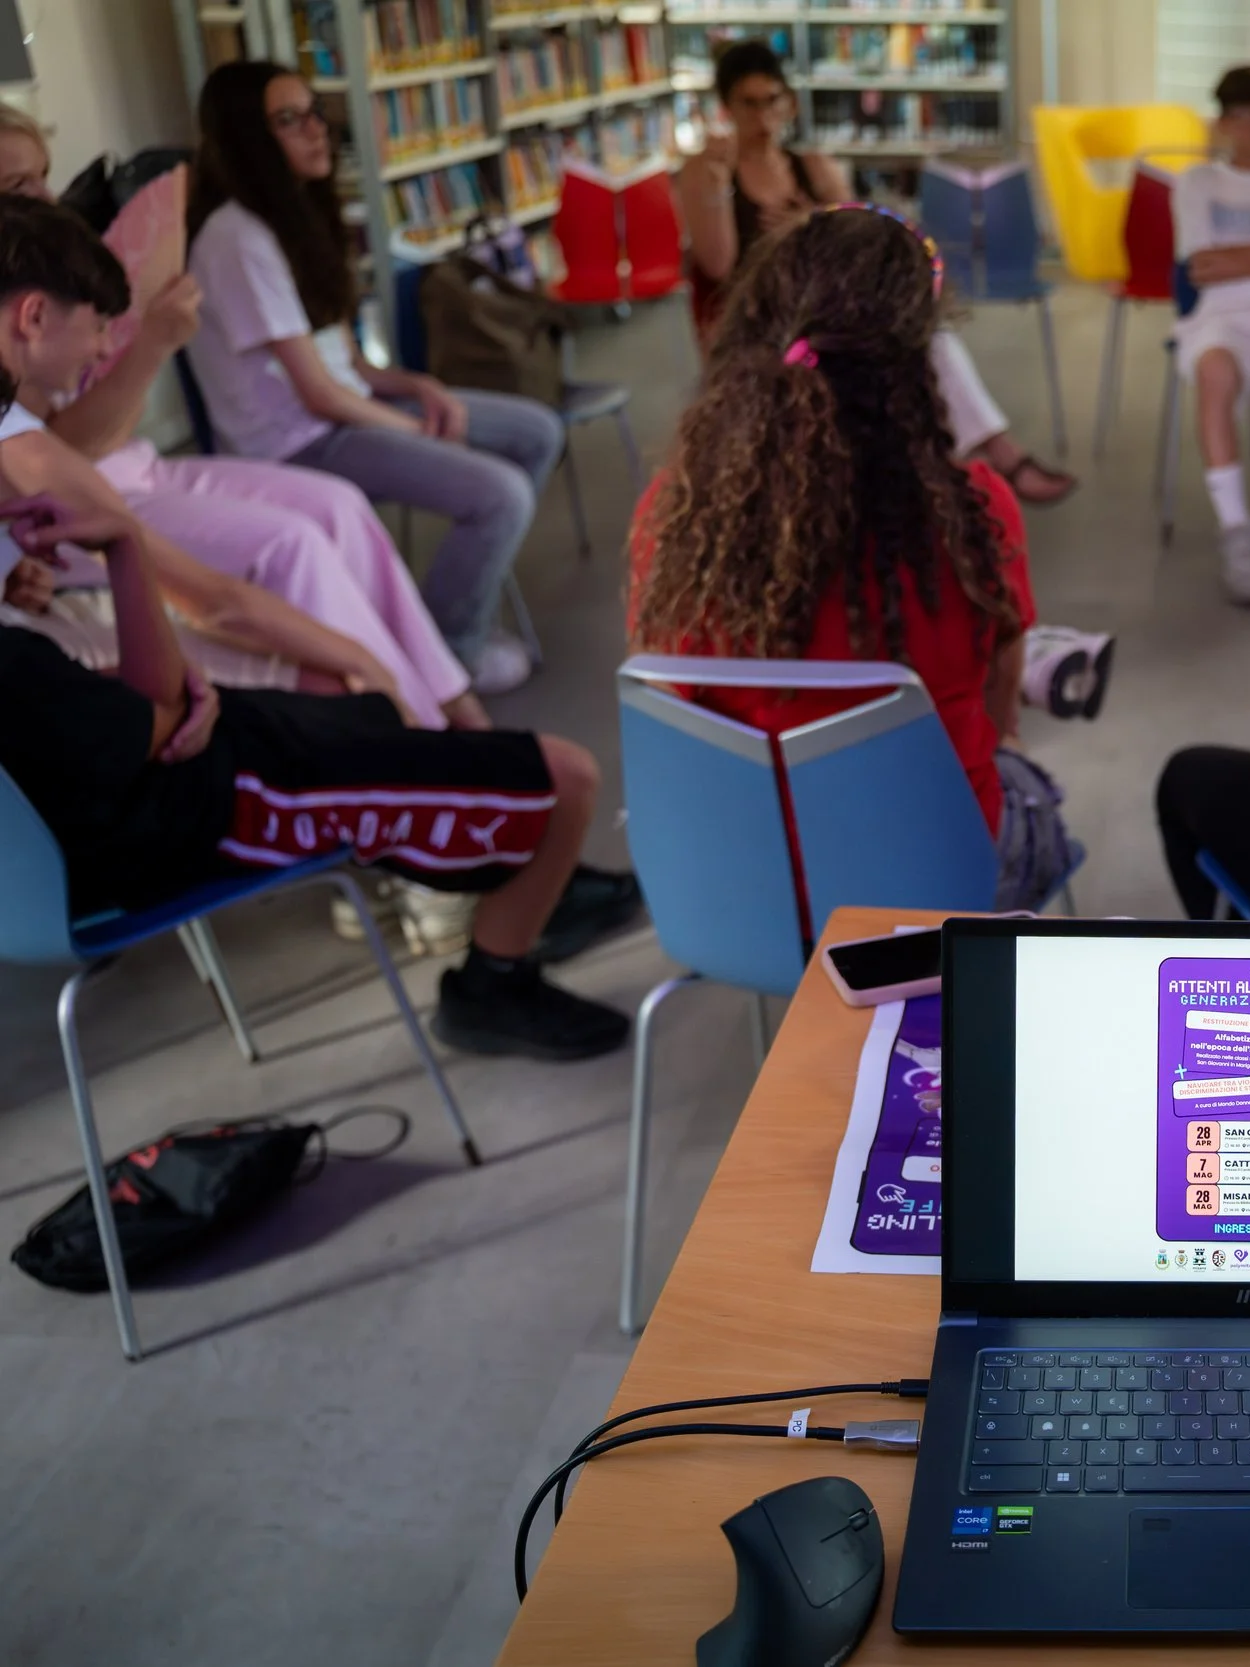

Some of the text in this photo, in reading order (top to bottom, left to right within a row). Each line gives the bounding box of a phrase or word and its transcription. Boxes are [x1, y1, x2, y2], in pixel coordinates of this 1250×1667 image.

[1169, 980, 1230, 993] ATTENTI
[1203, 1018, 1248, 1026] RESTITUZIONE
[1196, 1126, 1210, 1139] 28
[1225, 1129, 1245, 1137] SAN
[1200, 1158, 1206, 1171] 7
[1196, 1190, 1210, 1203] 28
[793, 1420, 802, 1432] PC
